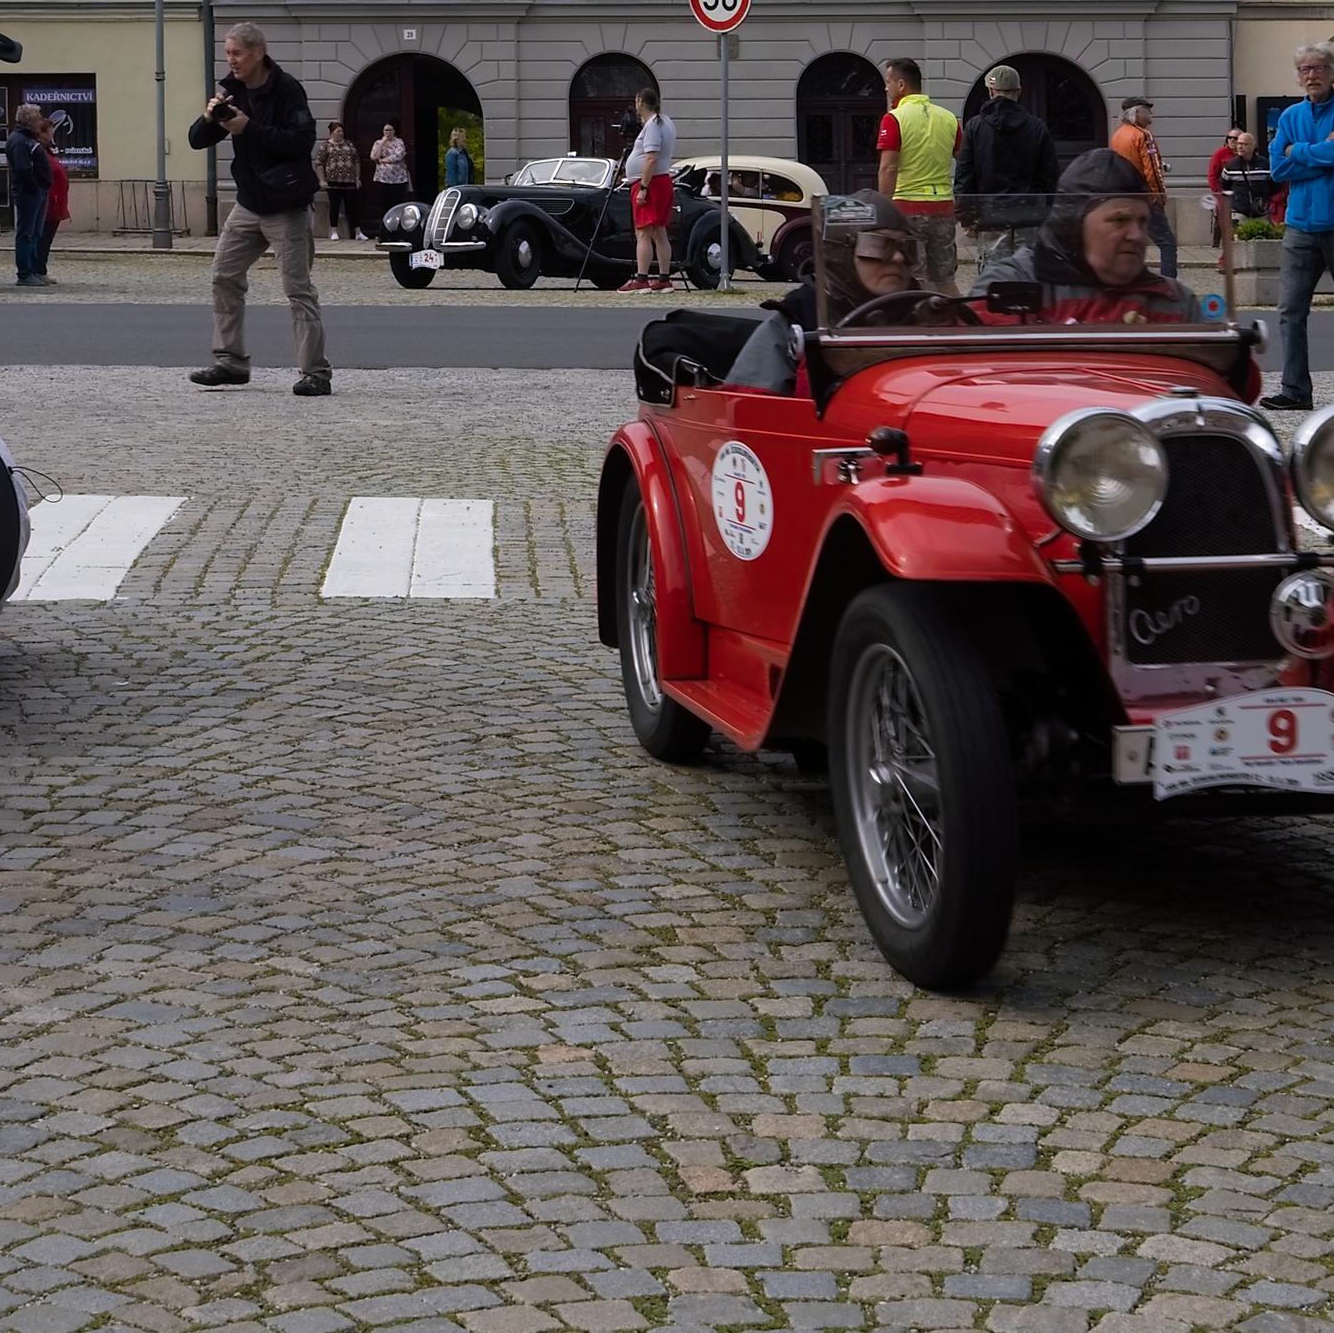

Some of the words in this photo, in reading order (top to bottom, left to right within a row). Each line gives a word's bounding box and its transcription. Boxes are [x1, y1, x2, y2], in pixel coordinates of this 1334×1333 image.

[26, 91, 93, 101] KADEŘNICTVÍ
[734, 481, 746, 523] 9
[1268, 709, 1299, 754] 9
